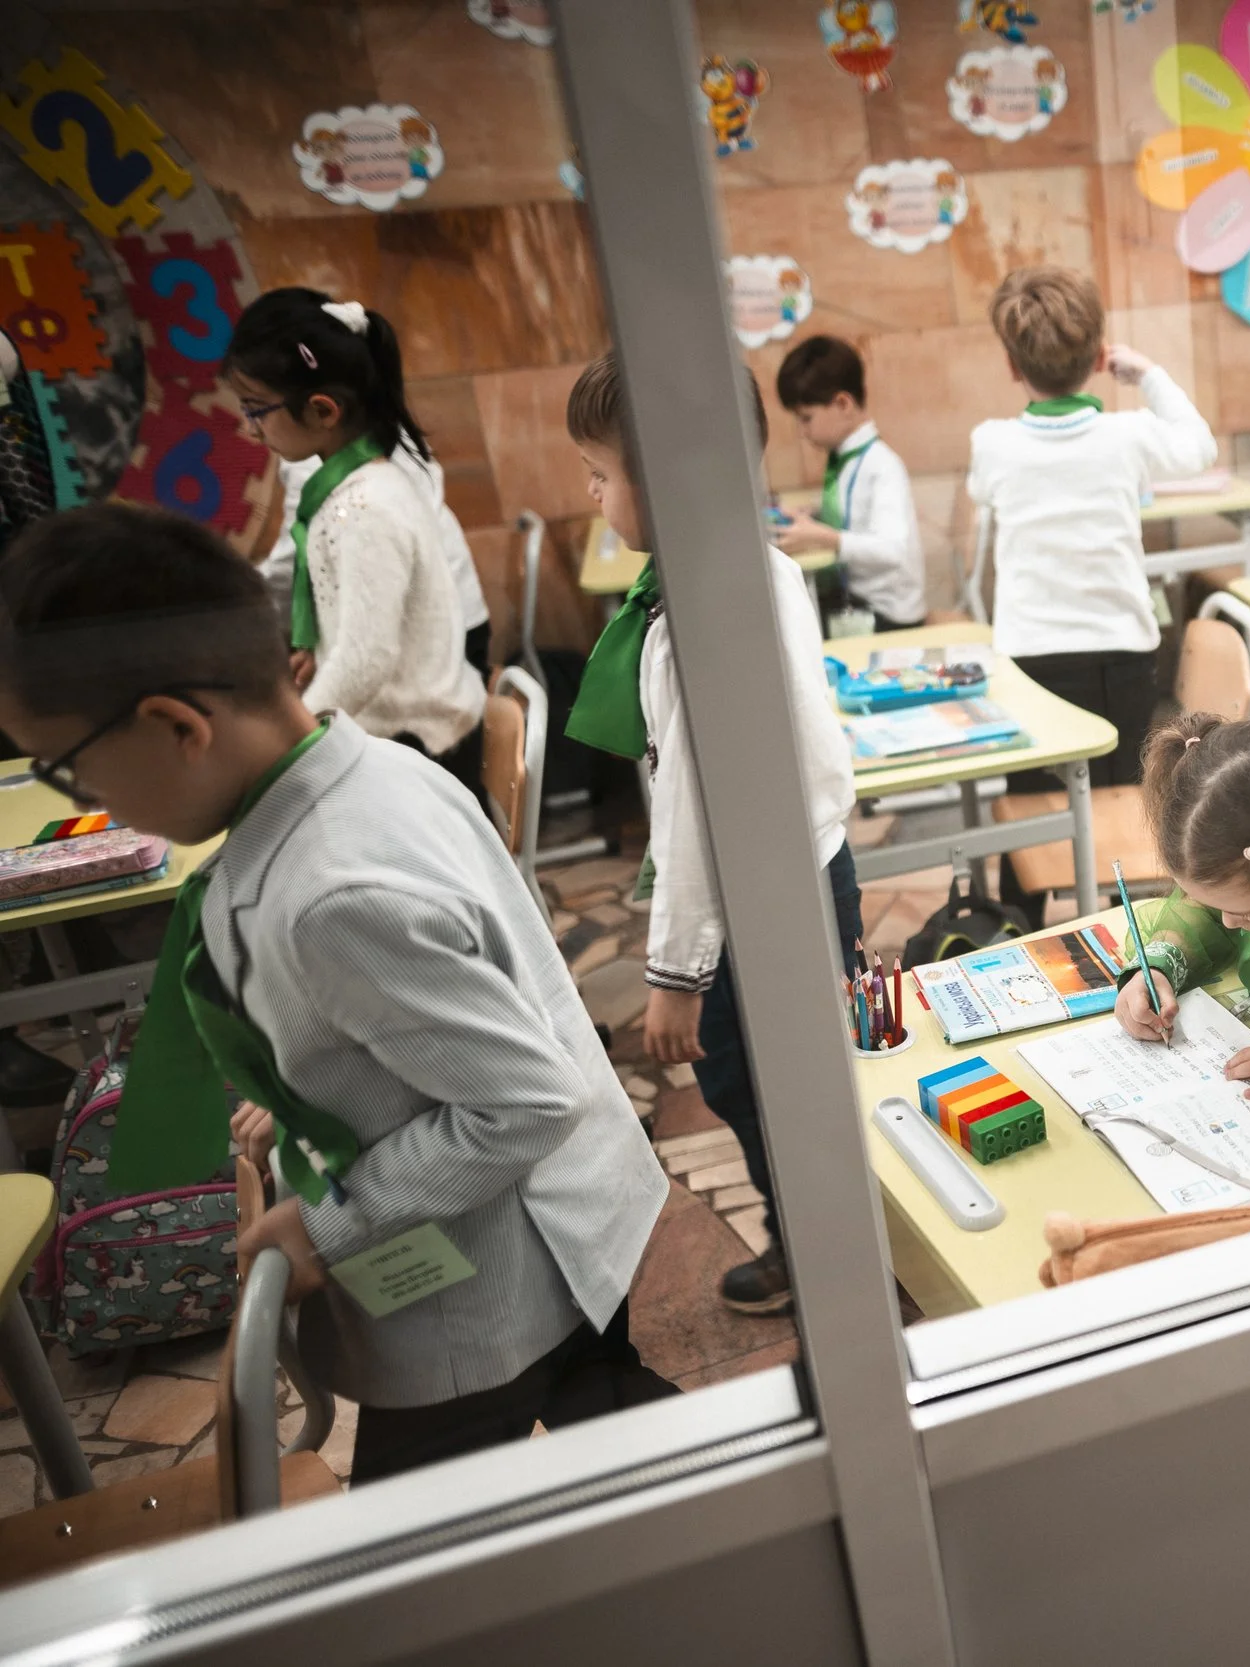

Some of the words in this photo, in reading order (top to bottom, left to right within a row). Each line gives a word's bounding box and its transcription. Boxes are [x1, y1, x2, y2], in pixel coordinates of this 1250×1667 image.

[31, 90, 153, 207] 2
[0, 245, 35, 297] Т
[150, 259, 233, 362] 3
[7, 302, 69, 353] Ф
[154, 428, 222, 522] 6
